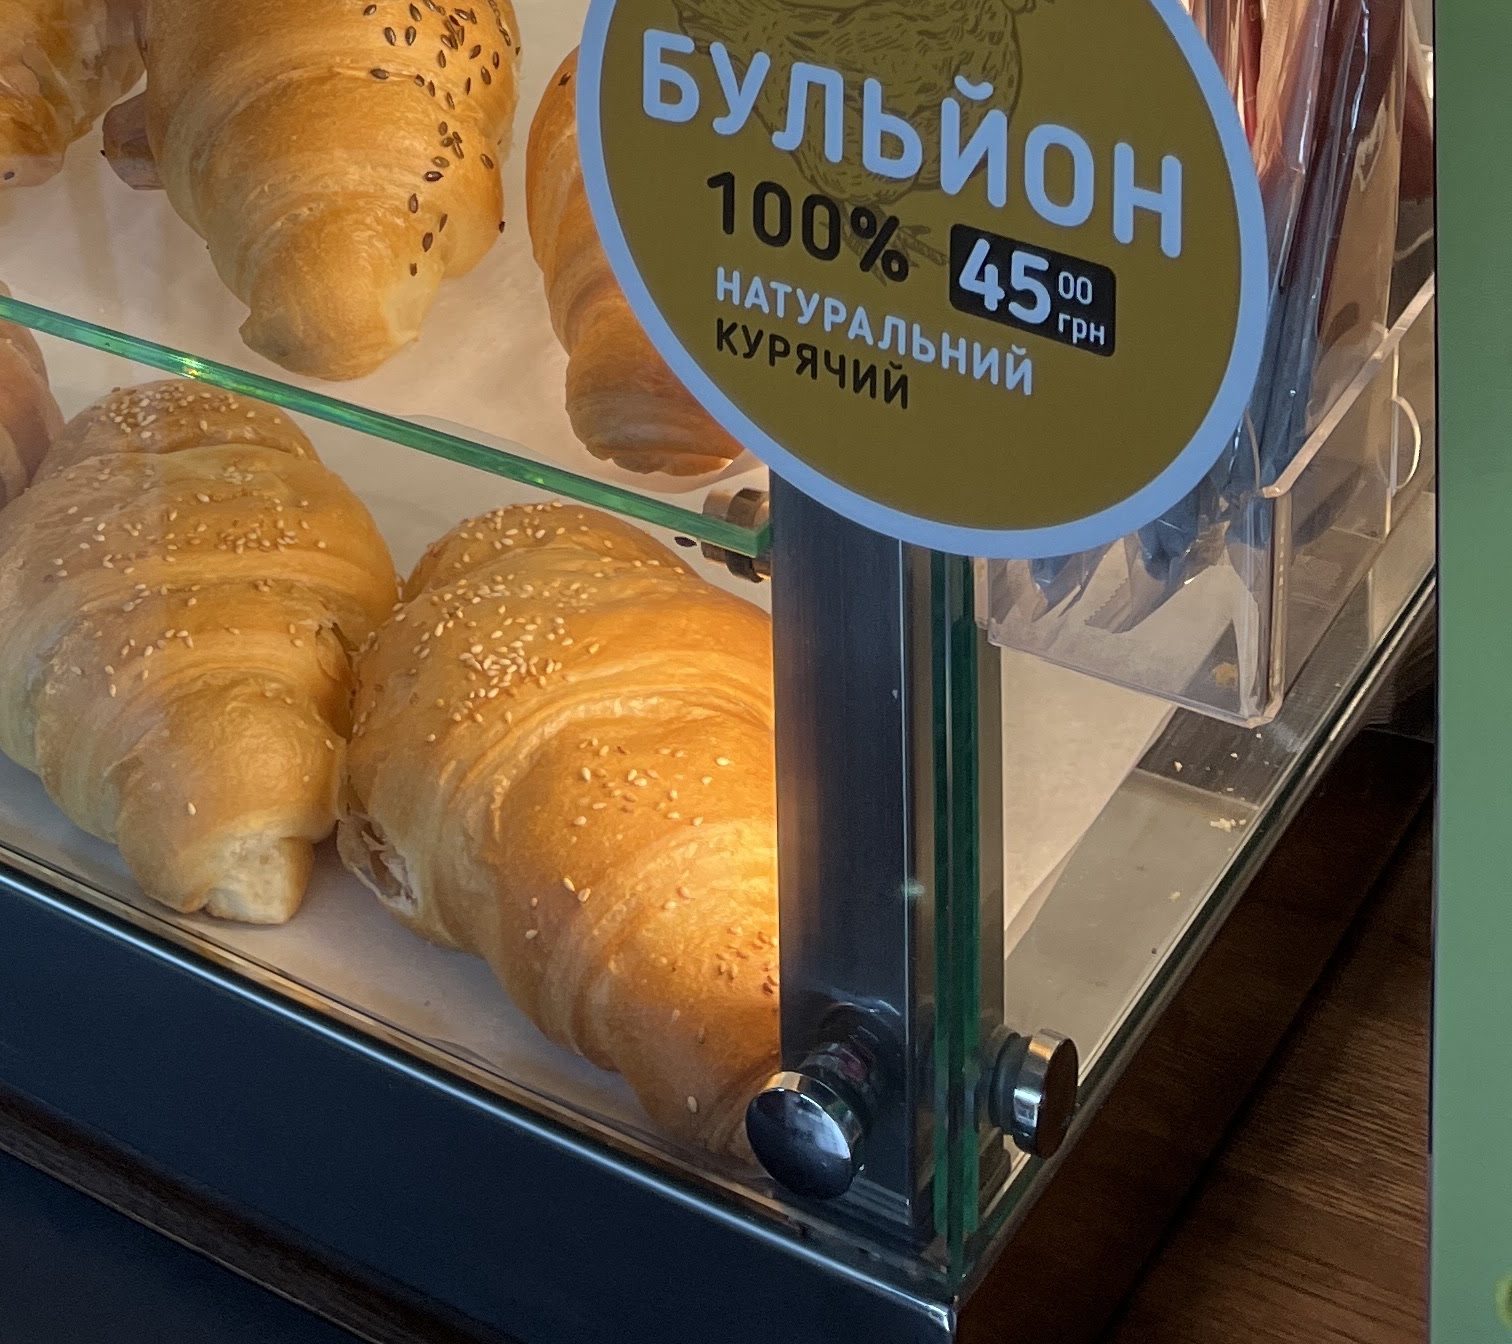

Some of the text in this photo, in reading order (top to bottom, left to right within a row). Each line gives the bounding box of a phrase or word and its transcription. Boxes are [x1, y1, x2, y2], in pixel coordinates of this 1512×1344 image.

[641, 26, 1183, 260] БУЛЬЙОН
[705, 169, 911, 284] 100%
[715, 265, 1035, 397] НАТУРАЛЬНИЙ
[957, 236, 1094, 326] 45 00
[1057, 310, 1108, 349] грн
[715, 318, 911, 411] КУРЯЧИЙ
